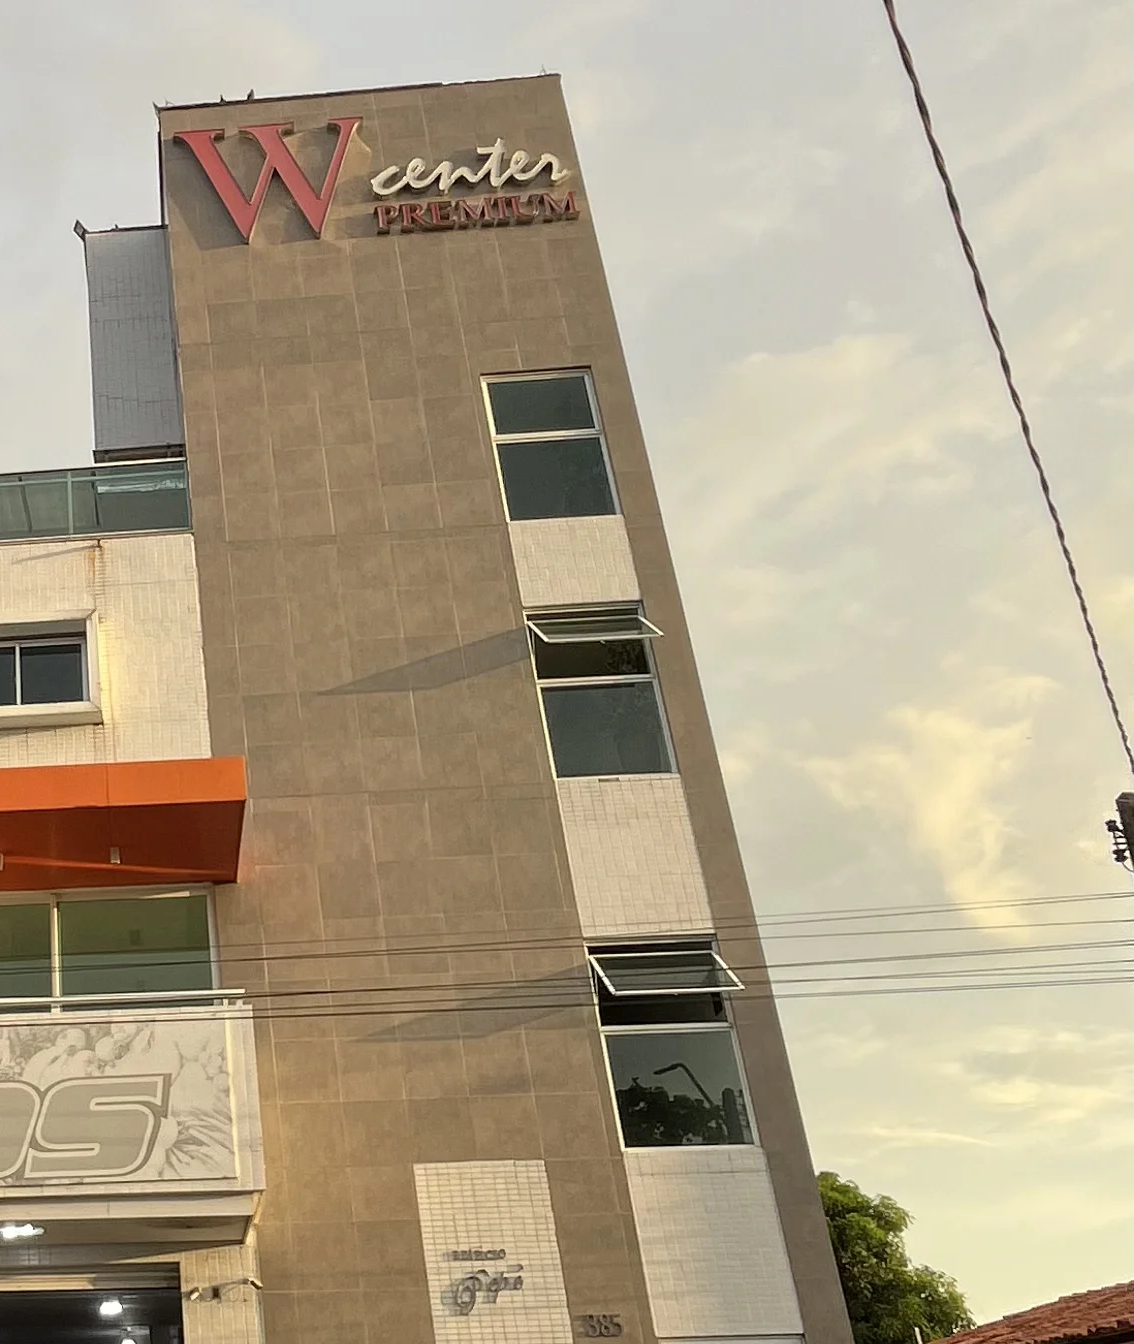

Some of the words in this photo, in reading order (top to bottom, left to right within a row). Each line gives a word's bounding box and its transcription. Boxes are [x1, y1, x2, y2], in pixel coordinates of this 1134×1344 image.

[172, 116, 363, 245] W
[370, 137, 570, 197] center
[374, 191, 581, 235] PREMIUM
[585, 1314, 624, 1338] 385
